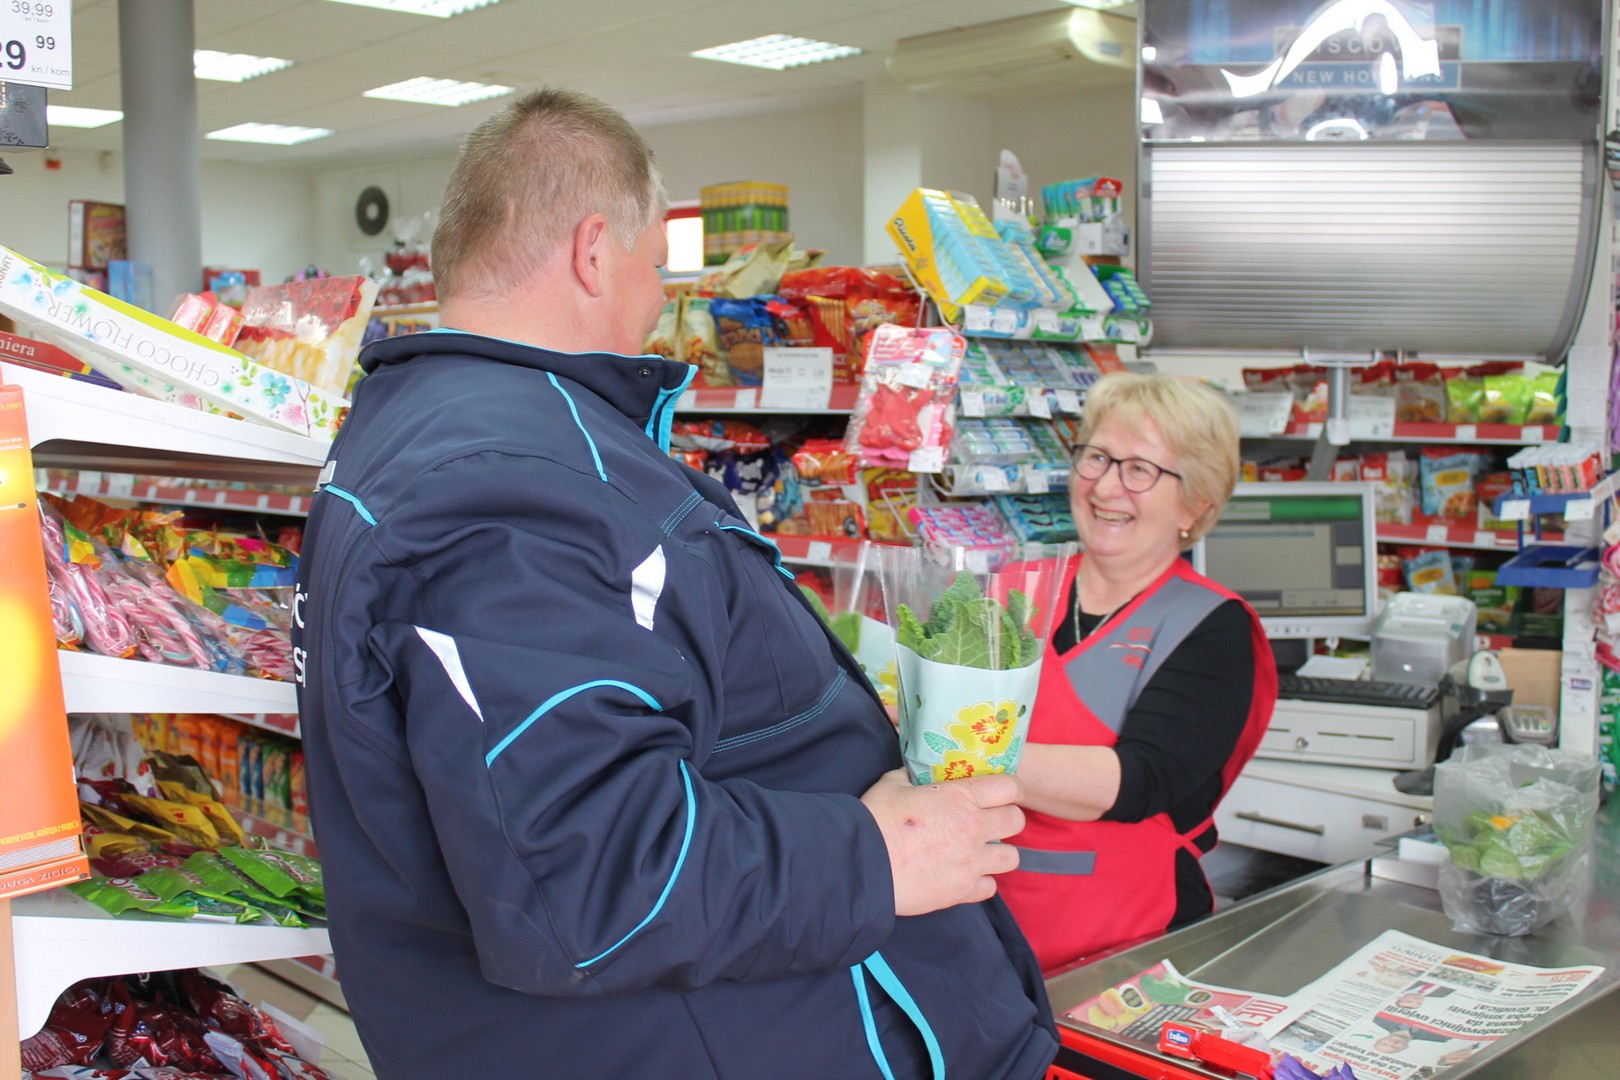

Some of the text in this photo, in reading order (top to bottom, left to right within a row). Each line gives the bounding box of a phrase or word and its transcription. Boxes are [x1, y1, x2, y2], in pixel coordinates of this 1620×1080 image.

[11, 0, 54, 17] 39,99
[0, 35, 56, 70] 9 99
[31, 64, 43, 74] kn
[51, 67, 70, 77] kom
[1292, 70, 1335, 83] NEW
[46, 291, 220, 387] CHOCO FLOWER
